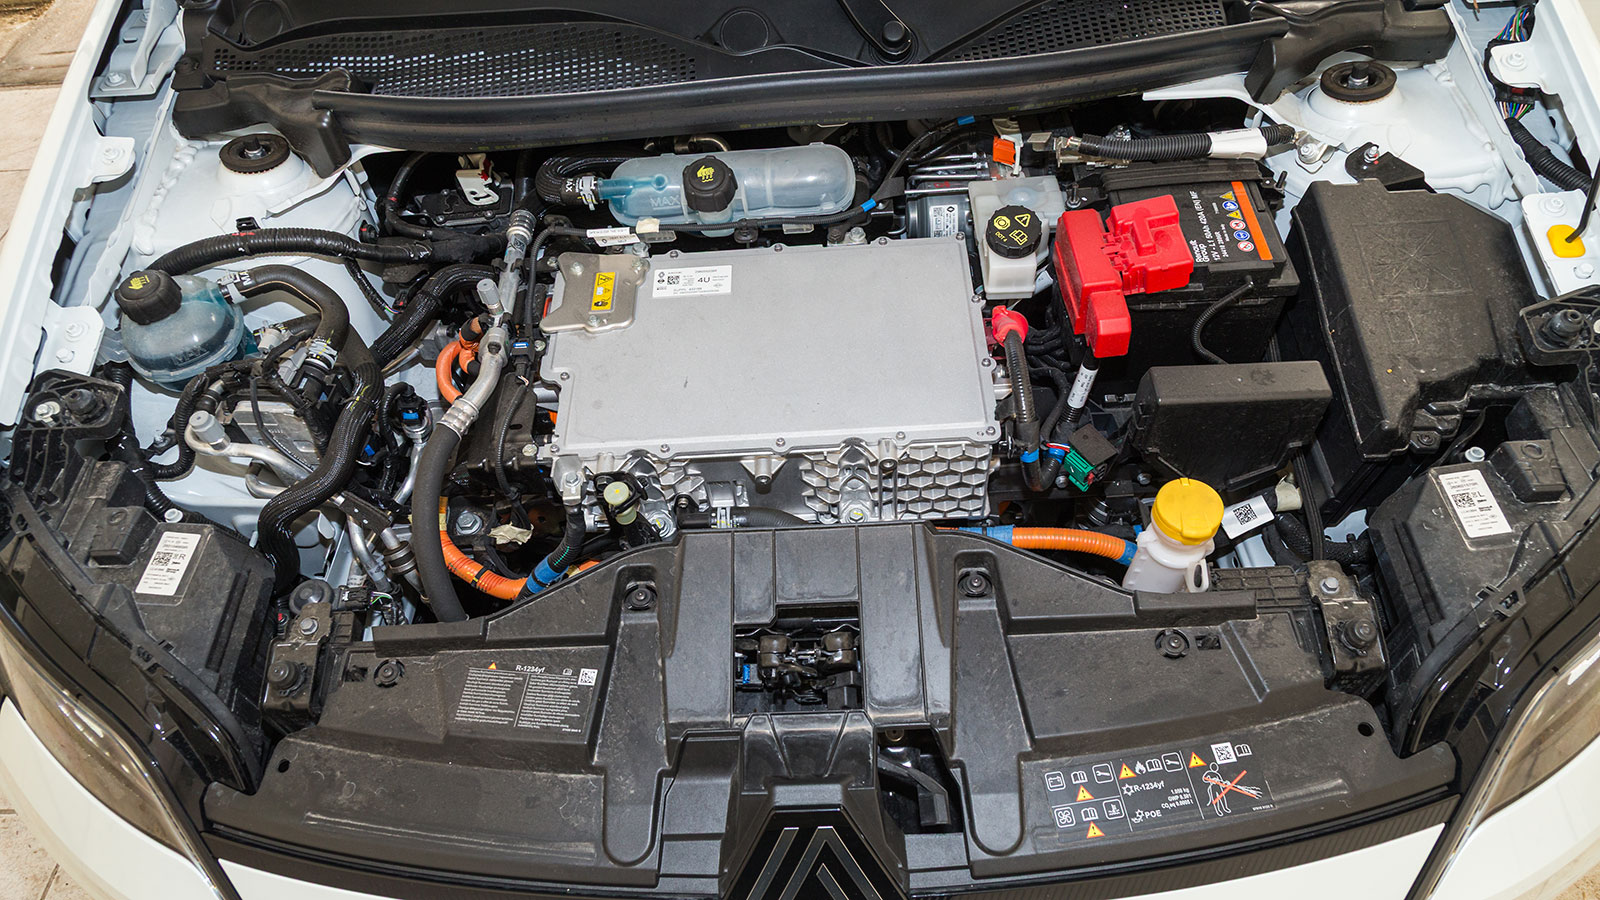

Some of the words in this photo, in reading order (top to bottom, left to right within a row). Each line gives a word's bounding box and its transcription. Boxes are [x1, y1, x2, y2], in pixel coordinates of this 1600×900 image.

[649, 195, 680, 207] MAX
[1197, 211, 1207, 224] 420A
[995, 231, 1005, 240] DOT
[1190, 240, 1203, 262] Renault
[1199, 243, 1210, 262] Group
[1210, 250, 1220, 260] 12V
[516, 664, 546, 674] R-1234yf
[1133, 780, 1165, 792] R-1234yf
[1144, 809, 1162, 819] POE
